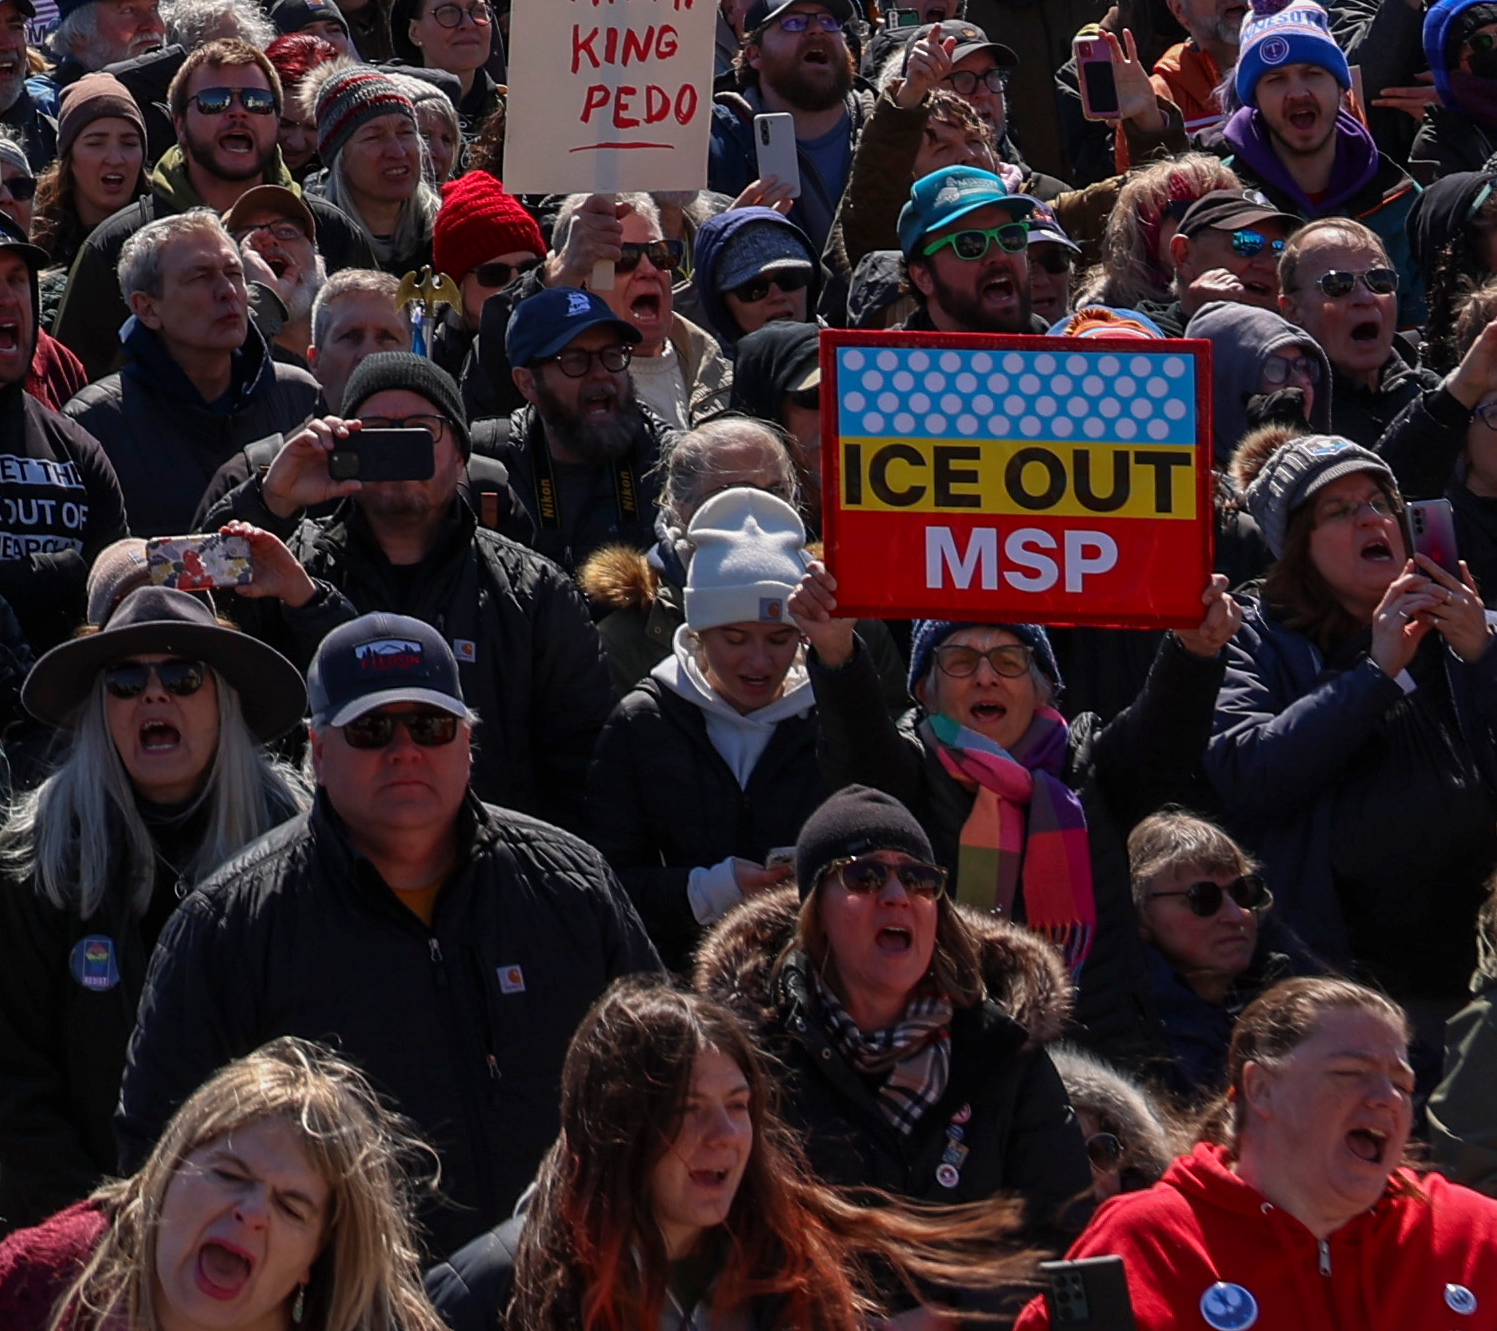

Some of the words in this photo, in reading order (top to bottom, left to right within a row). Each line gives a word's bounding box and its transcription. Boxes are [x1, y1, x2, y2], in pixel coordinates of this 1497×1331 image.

[569, 23, 678, 74] KING
[578, 83, 697, 129] PEDO
[541, 479, 555, 519] Nikon
[621, 471, 635, 511] Nikon
[844, 444, 980, 511] ICE
[1004, 449, 1192, 513] OUT
[61, 499, 88, 527] OF
[925, 526, 1119, 592] MSP
